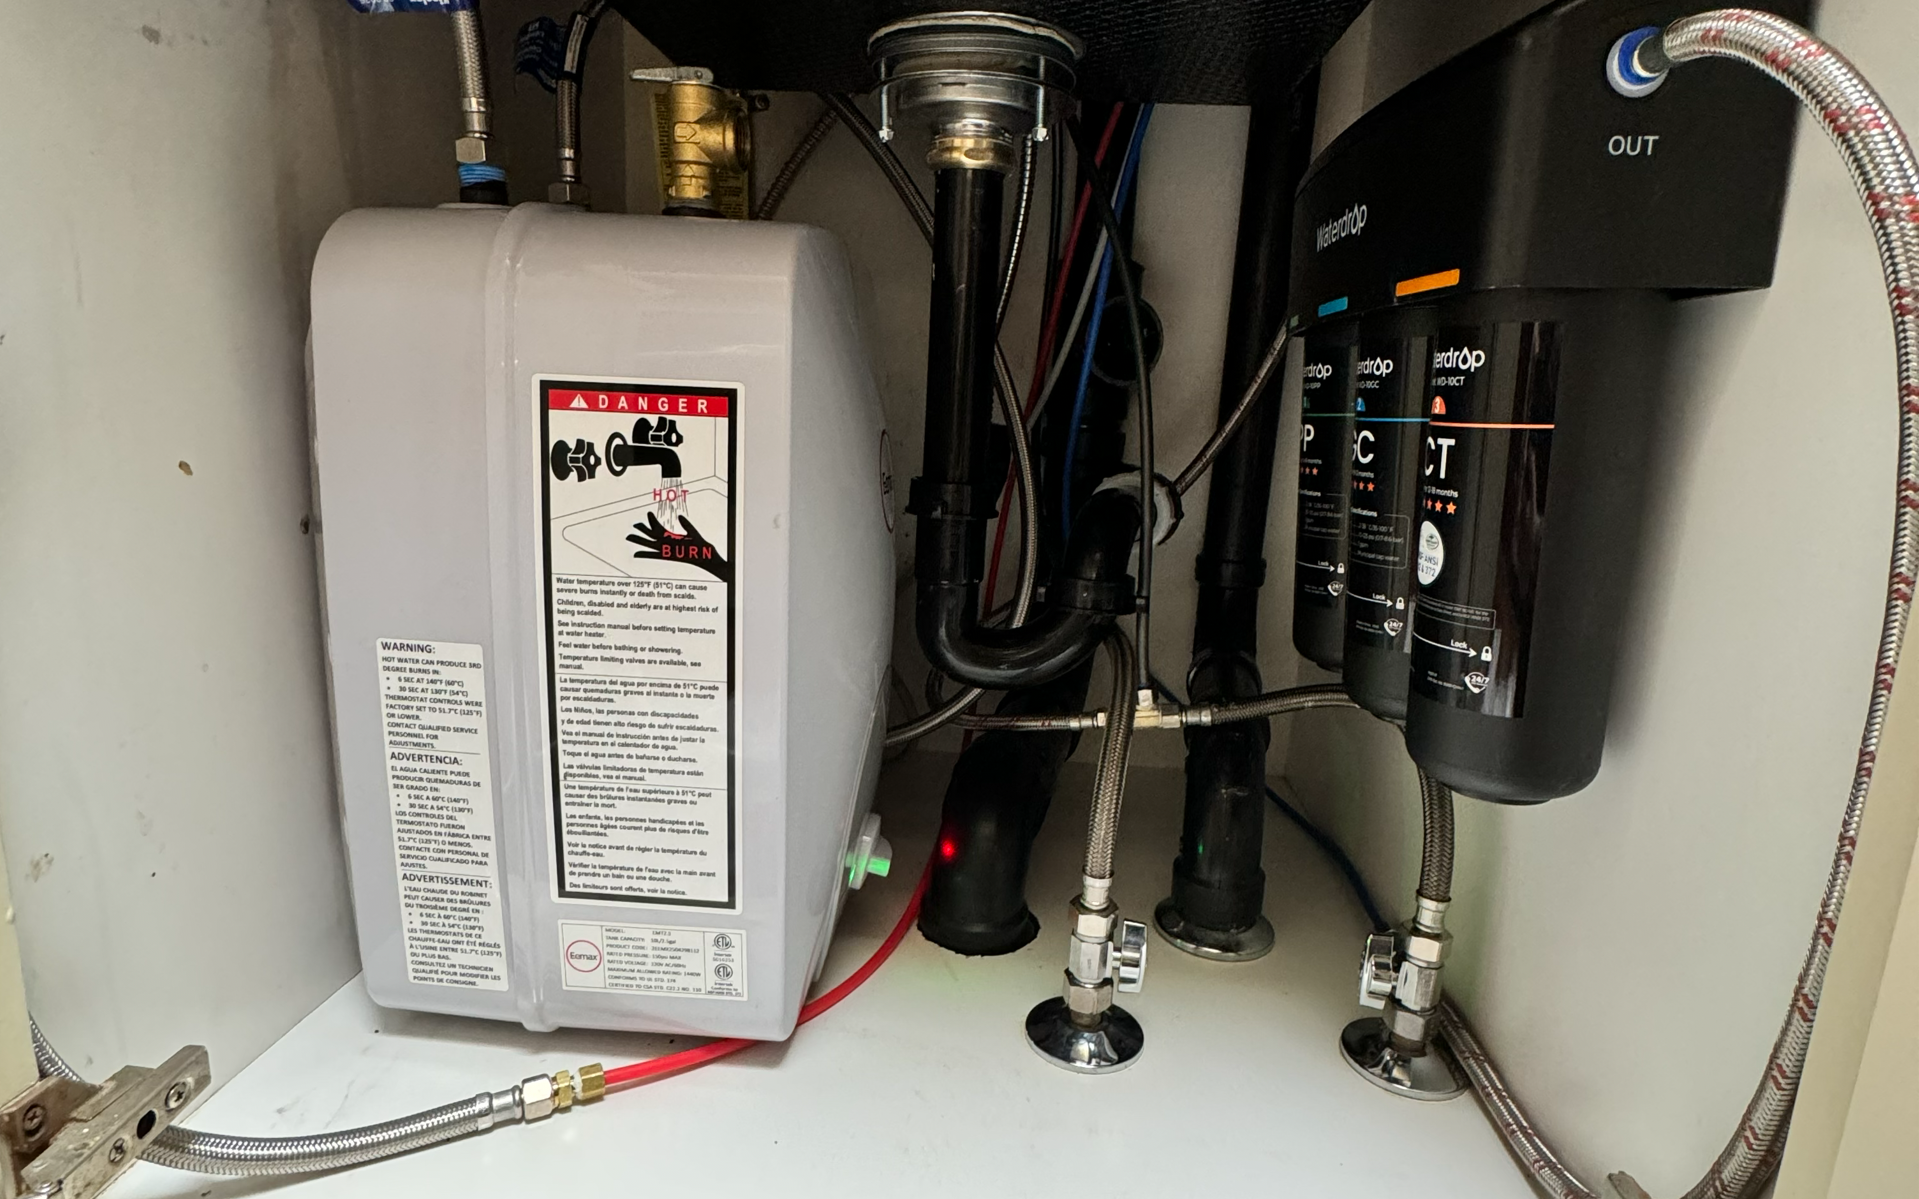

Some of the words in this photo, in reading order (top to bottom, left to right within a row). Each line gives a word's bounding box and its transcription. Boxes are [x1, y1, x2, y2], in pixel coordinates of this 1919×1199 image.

[1608, 134, 1660, 156] OUT
[1315, 203, 1368, 252] Waterdrop
[598, 394, 708, 413] DANGER
[1424, 436, 1456, 479] CT
[653, 488, 689, 503] HOT
[662, 544, 712, 560] BURN
[577, 578, 615, 587] temperature
[653, 581, 673, 591] (51°C)
[580, 587, 598, 595] burns
[600, 588, 627, 598] instantly
[1372, 593, 1386, 601] Lock
[557, 598, 585, 607] Children,
[588, 600, 614, 608] disabled
[630, 602, 651, 611] elderly
[672, 604, 696, 613] highest
[557, 608, 575, 617] being
[571, 621, 605, 629] instruction
[654, 626, 676, 634] setting
[678, 626, 716, 634] temperature
[381, 641, 435, 654] WARNING:
[614, 644, 638, 653] bathing
[648, 646, 682, 656] showering.
[1450, 639, 1468, 650] Lock
[436, 660, 467, 668] PRODUCE
[559, 653, 598, 662] Temperature
[600, 655, 624, 665] limiting
[659, 659, 688, 667] available,
[383, 665, 407, 673] DEGREE
[409, 667, 430, 675] BURNS
[445, 679, 464, 688] (60°C)
[569, 677, 607, 685] temperatura
[683, 682, 698, 690] 51°C
[1471, 675, 1490, 684] 24/7
[385, 694, 427, 703] THERMOSTAT
[429, 697, 463, 706] CONTROLS
[449, 690, 468, 698] (54°C)
[386, 703, 414, 711] FACTORY
[439, 707, 458, 715] 51.7°C
[460, 709, 482, 718] (125°F)
[397, 713, 422, 721] LOWER.
[387, 721, 416, 729] CONTACT
[418, 724, 451, 732] QUALIFIED
[453, 727, 478, 735] SERVICE
[388, 730, 424, 739] PERSONNEL
[389, 740, 436, 749] ADJUSTMENTS.
[391, 752, 462, 765] ADVERTENCIA:
[419, 768, 448, 776] CALIENTE
[450, 770, 470, 778] PUEDE
[402, 873, 492, 888] ADVERTISSEMENT:
